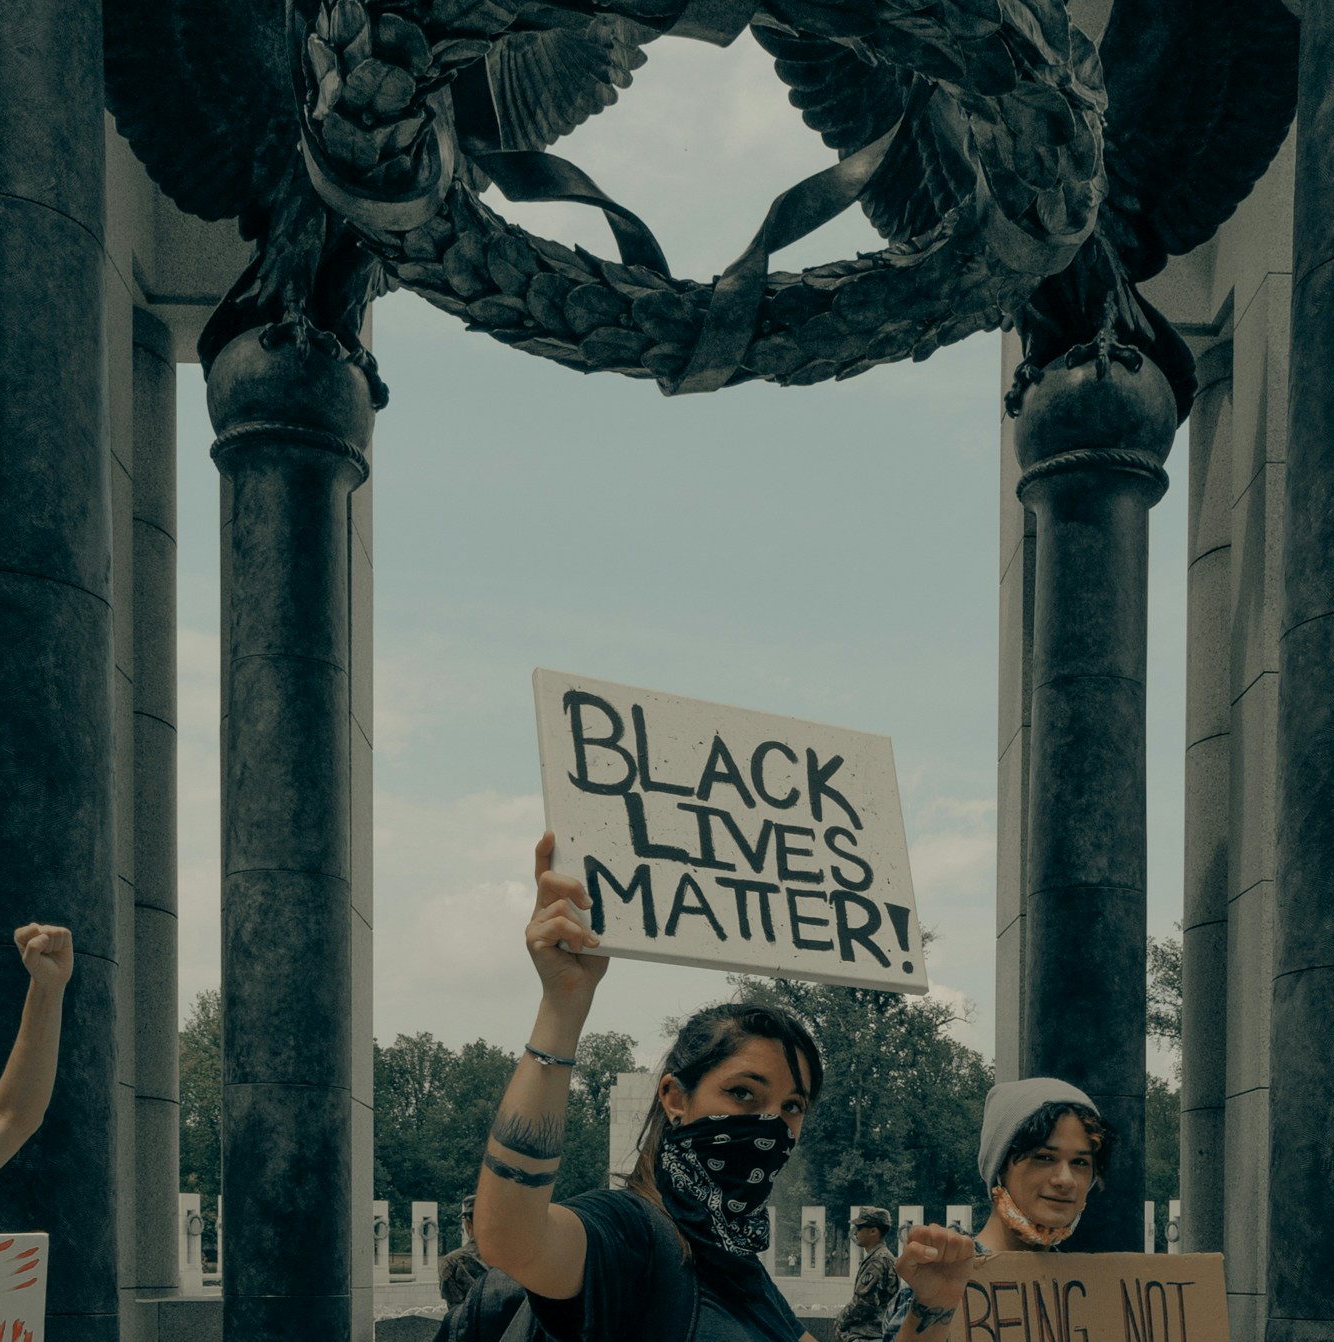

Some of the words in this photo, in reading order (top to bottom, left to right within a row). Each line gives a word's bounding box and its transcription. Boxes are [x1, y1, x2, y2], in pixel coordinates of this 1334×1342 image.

[562, 688, 863, 830] BLACK
[624, 792, 873, 892] LIVES
[584, 854, 914, 975] MATTER!
